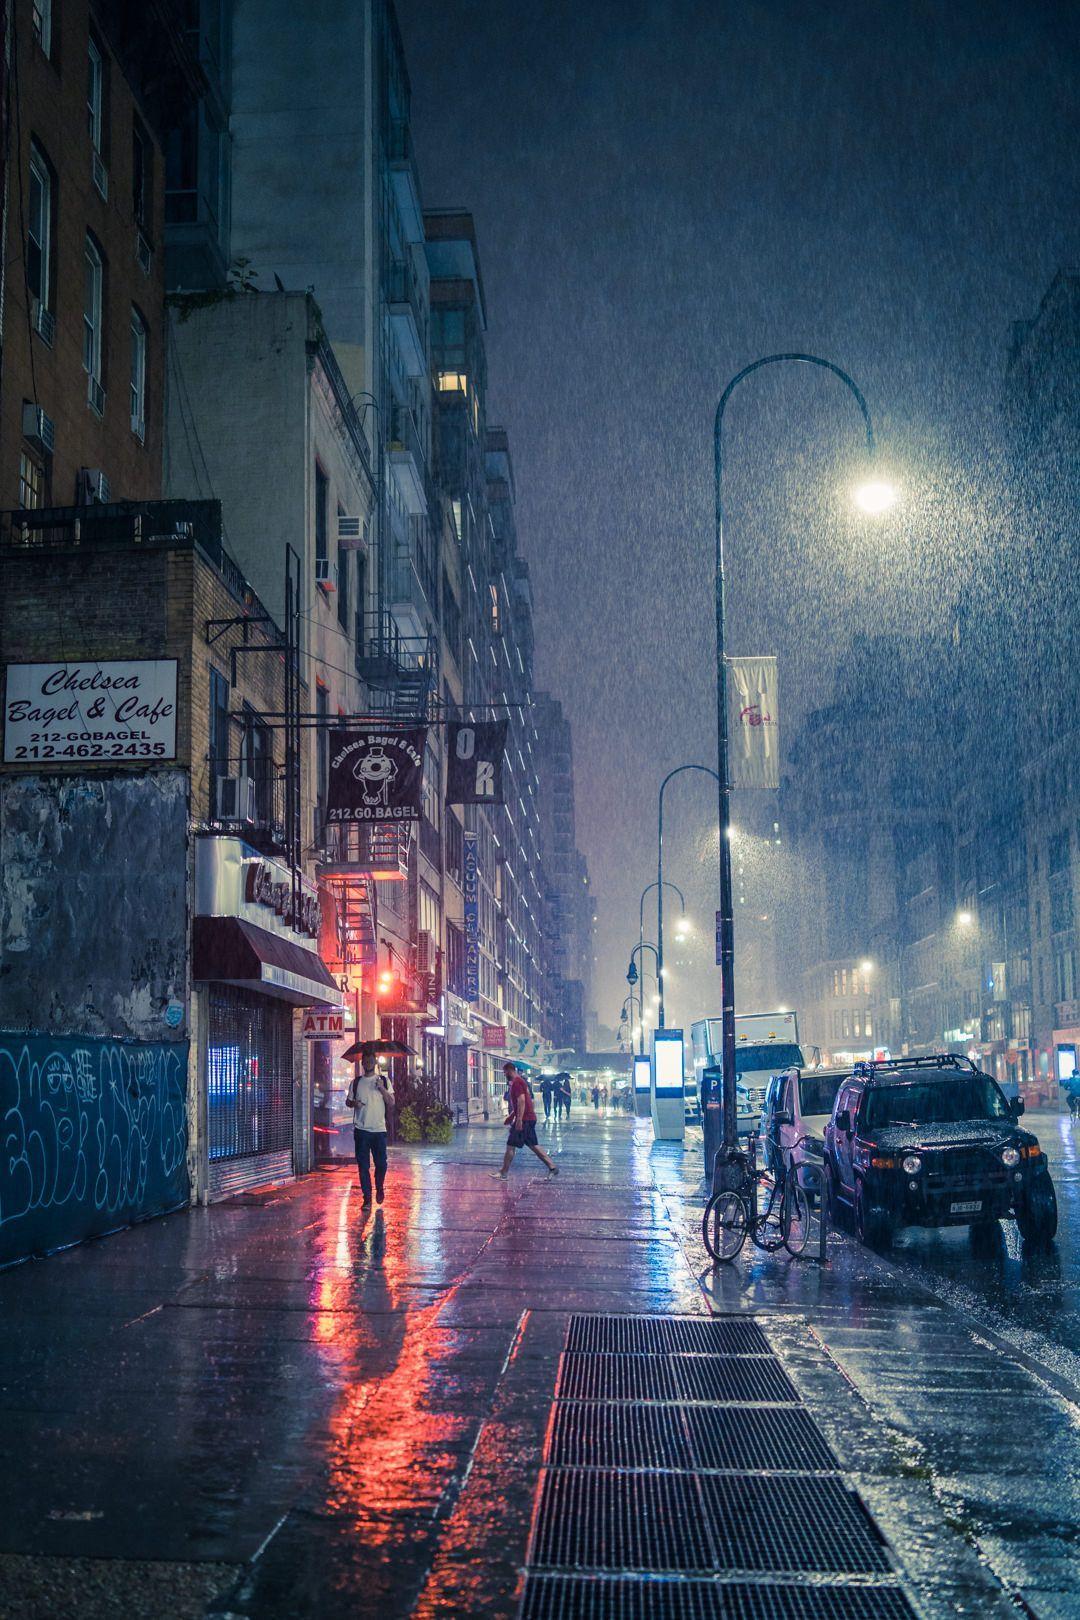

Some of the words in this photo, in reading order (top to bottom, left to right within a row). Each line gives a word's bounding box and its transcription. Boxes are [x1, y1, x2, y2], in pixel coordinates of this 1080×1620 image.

[41, 669, 141, 696] Chelsea
[8, 700, 79, 728] Bagel
[87, 697, 106, 719] &
[114, 696, 174, 725] Cafe
[30, 731, 151, 742] 212-GOBAGEL
[15, 743, 166, 759] 212-462-2435
[331, 739, 366, 769] Chelsea
[367, 735, 399, 746] Bagel
[466, 842, 477, 903] VACUUM
[466, 913, 478, 997] CLEANERS
[304, 1016, 343, 1031] ATM
[711, 1080, 718, 1090] P
